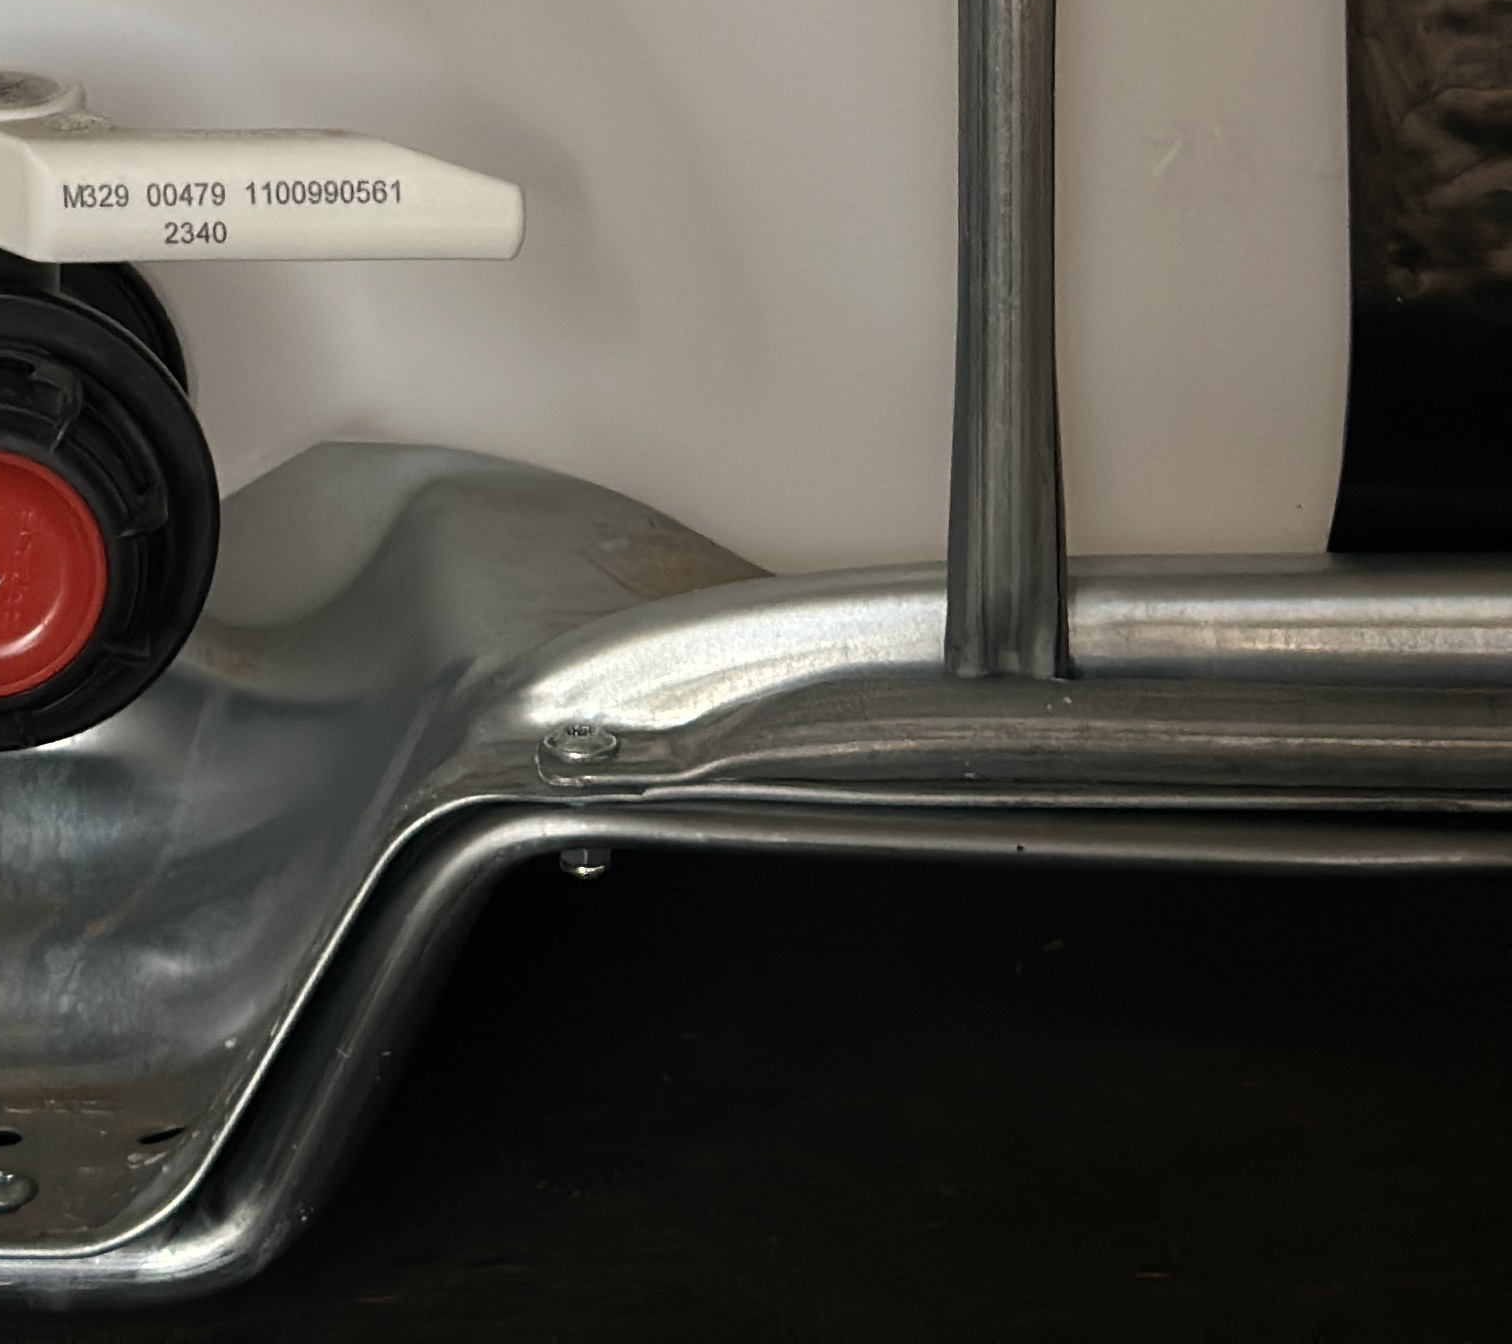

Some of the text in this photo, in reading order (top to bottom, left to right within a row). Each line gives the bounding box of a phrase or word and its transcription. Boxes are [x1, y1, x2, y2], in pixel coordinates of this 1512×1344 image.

[62, 179, 402, 208] M329 00479 1100990561
[164, 221, 228, 245] 2340
